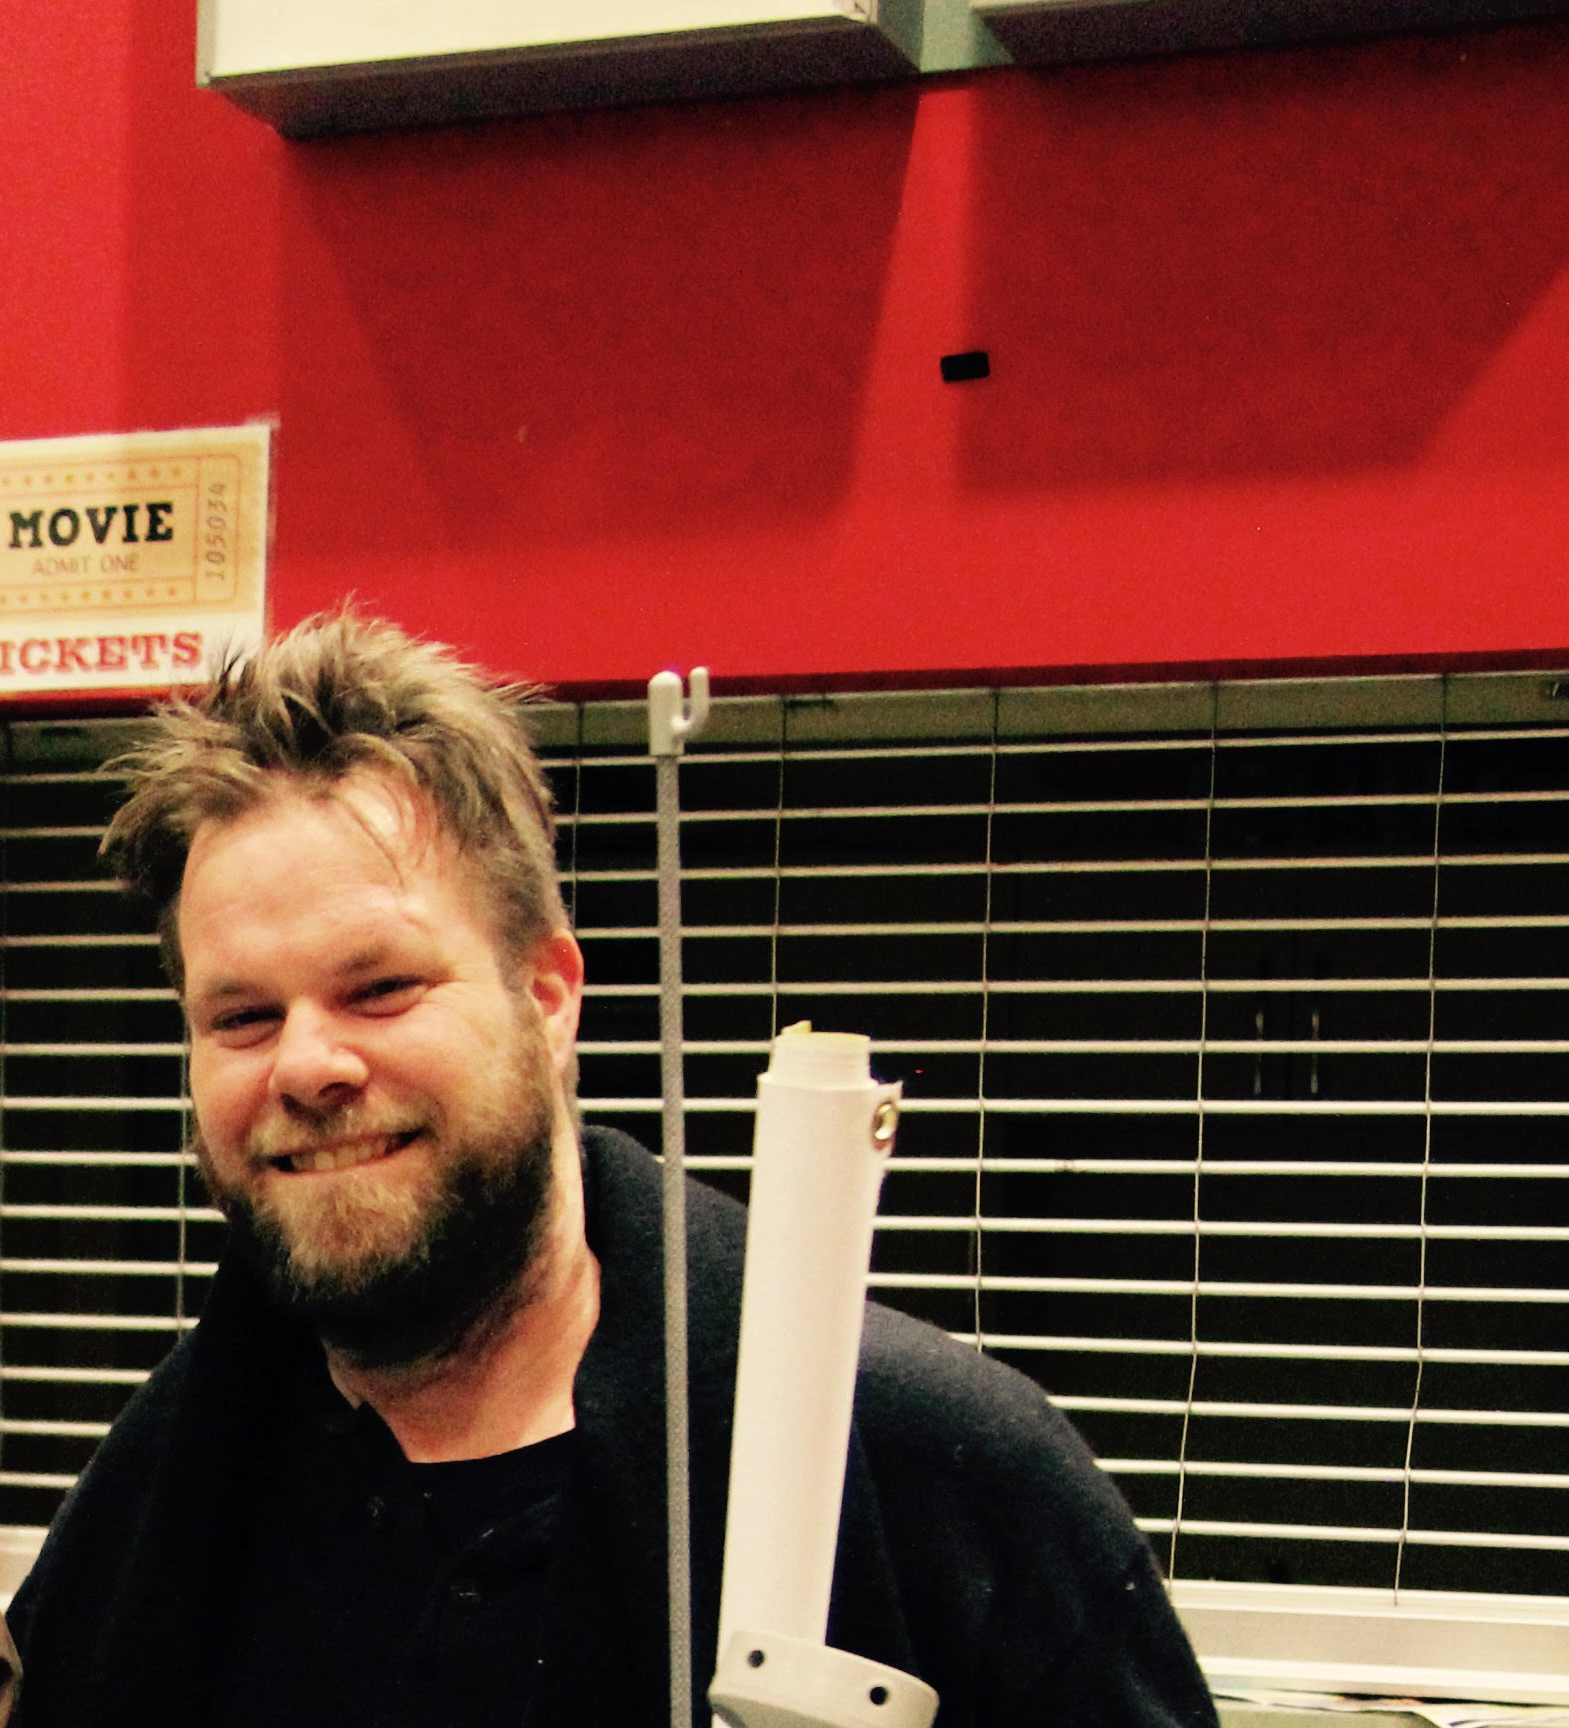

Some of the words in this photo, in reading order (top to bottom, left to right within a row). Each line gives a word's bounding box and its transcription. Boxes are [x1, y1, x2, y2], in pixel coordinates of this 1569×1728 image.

[8, 502, 174, 549] MOVIE
[204, 482, 227, 582] 105034
[31, 555, 90, 576] ADMIT
[101, 552, 142, 573] ONE
